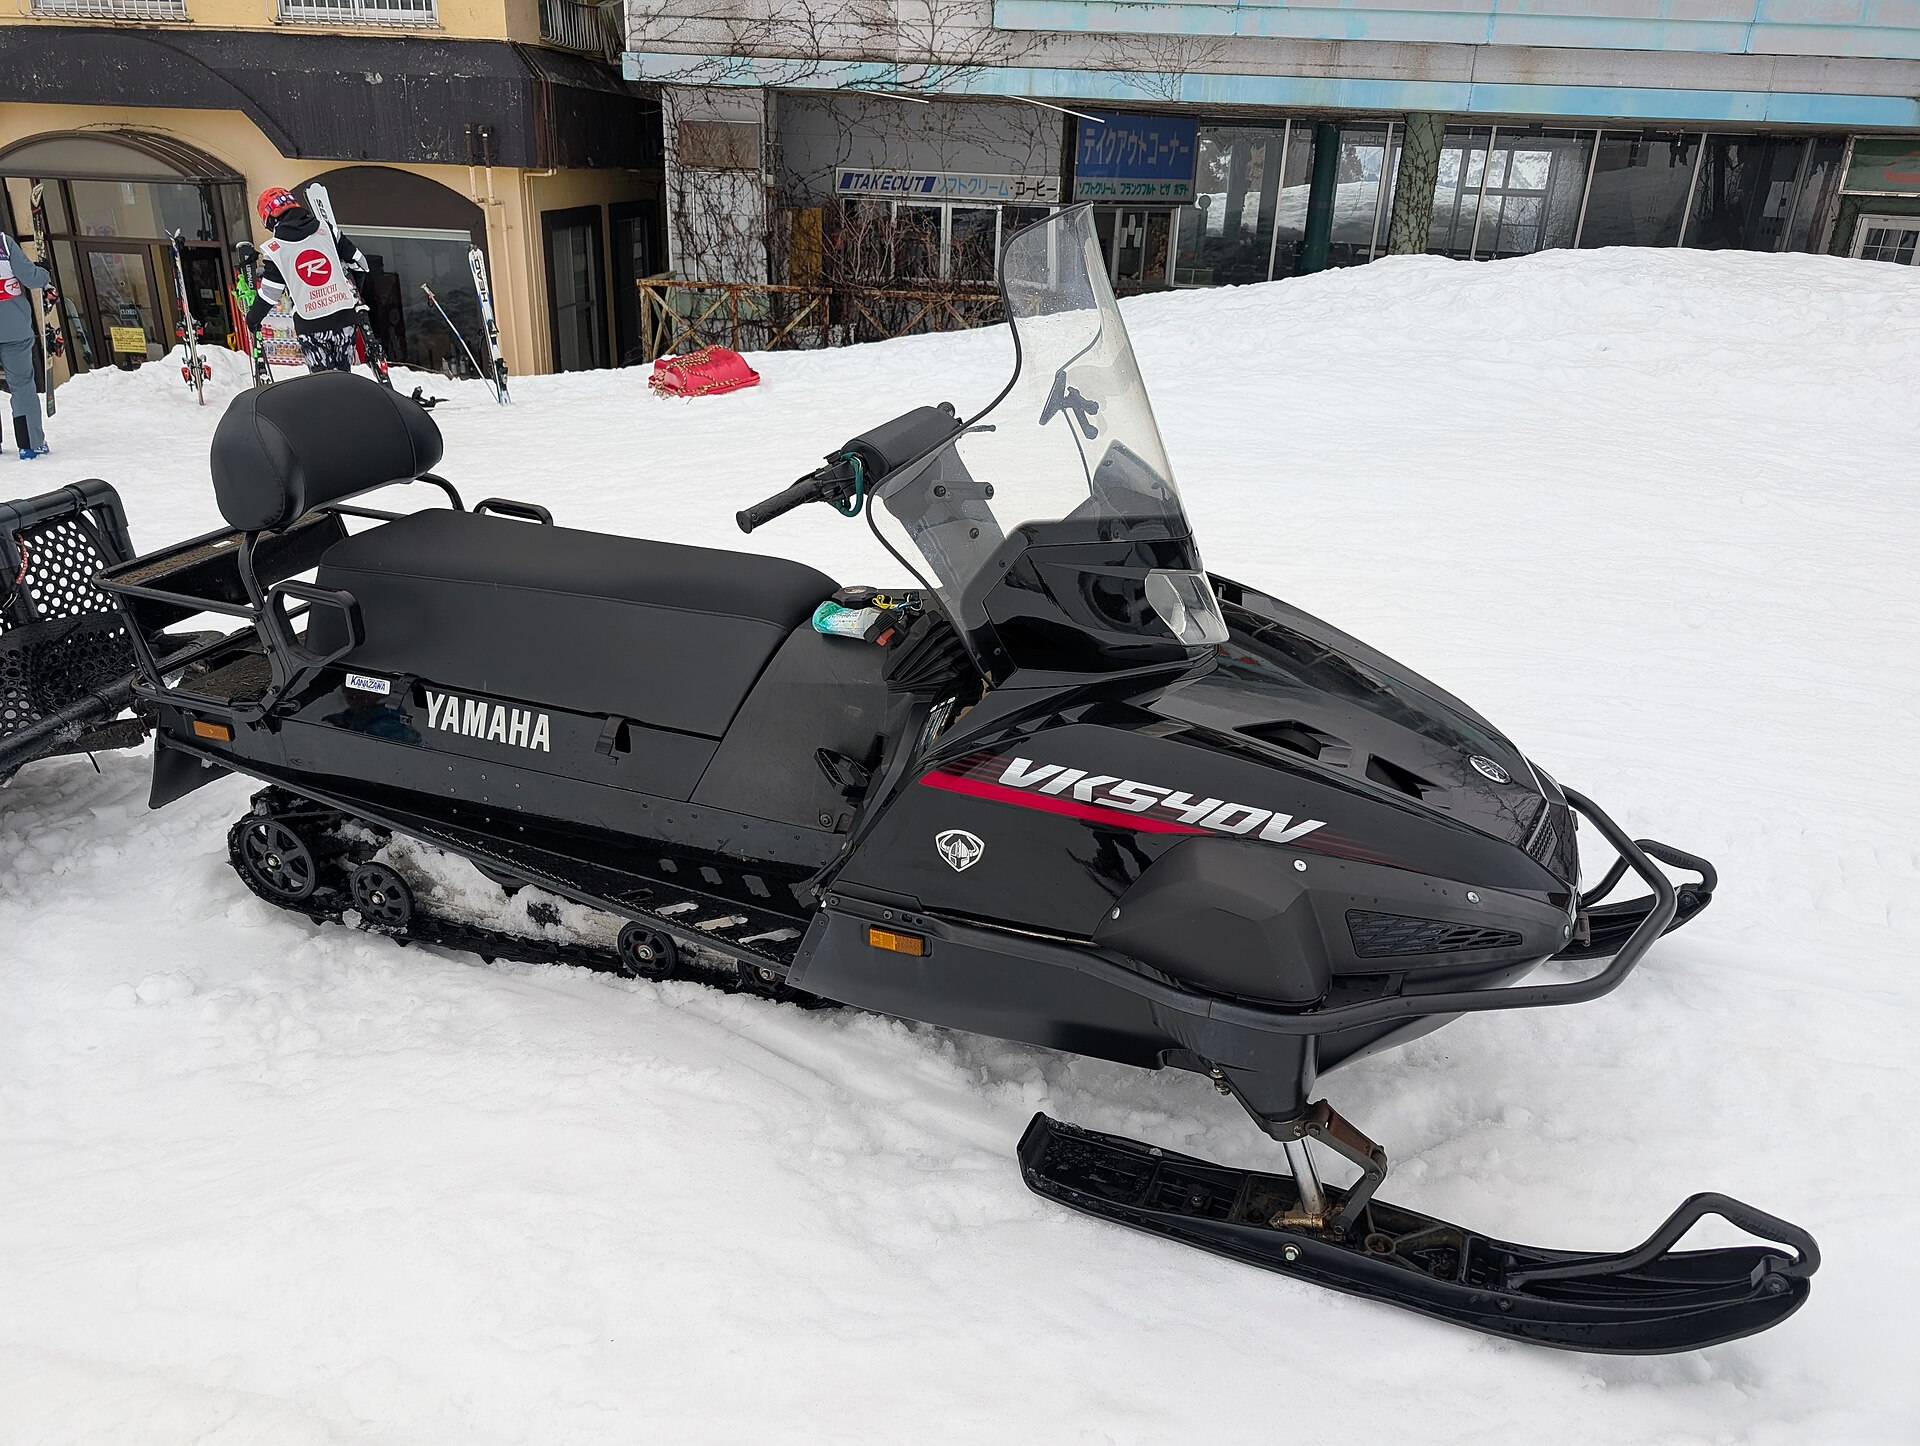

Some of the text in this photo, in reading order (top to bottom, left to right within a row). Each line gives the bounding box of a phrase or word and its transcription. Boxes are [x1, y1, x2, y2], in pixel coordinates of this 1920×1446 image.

[1084, 128, 1189, 166] テイクアウトコーナー
[852, 173, 925, 192] TAKEOUT
[1079, 182, 1116, 196] ソフトクリーム
[1120, 182, 1157, 196] フランクフルト
[474, 258, 488, 303] HEAD
[309, 283, 338, 300] ISHIUCHI
[304, 301, 317, 312] PRO
[317, 297, 329, 308] SKI
[350, 676, 386, 692] KANAZAWA
[425, 690, 550, 752] YAMAHA
[998, 757, 1328, 844] VK540V
